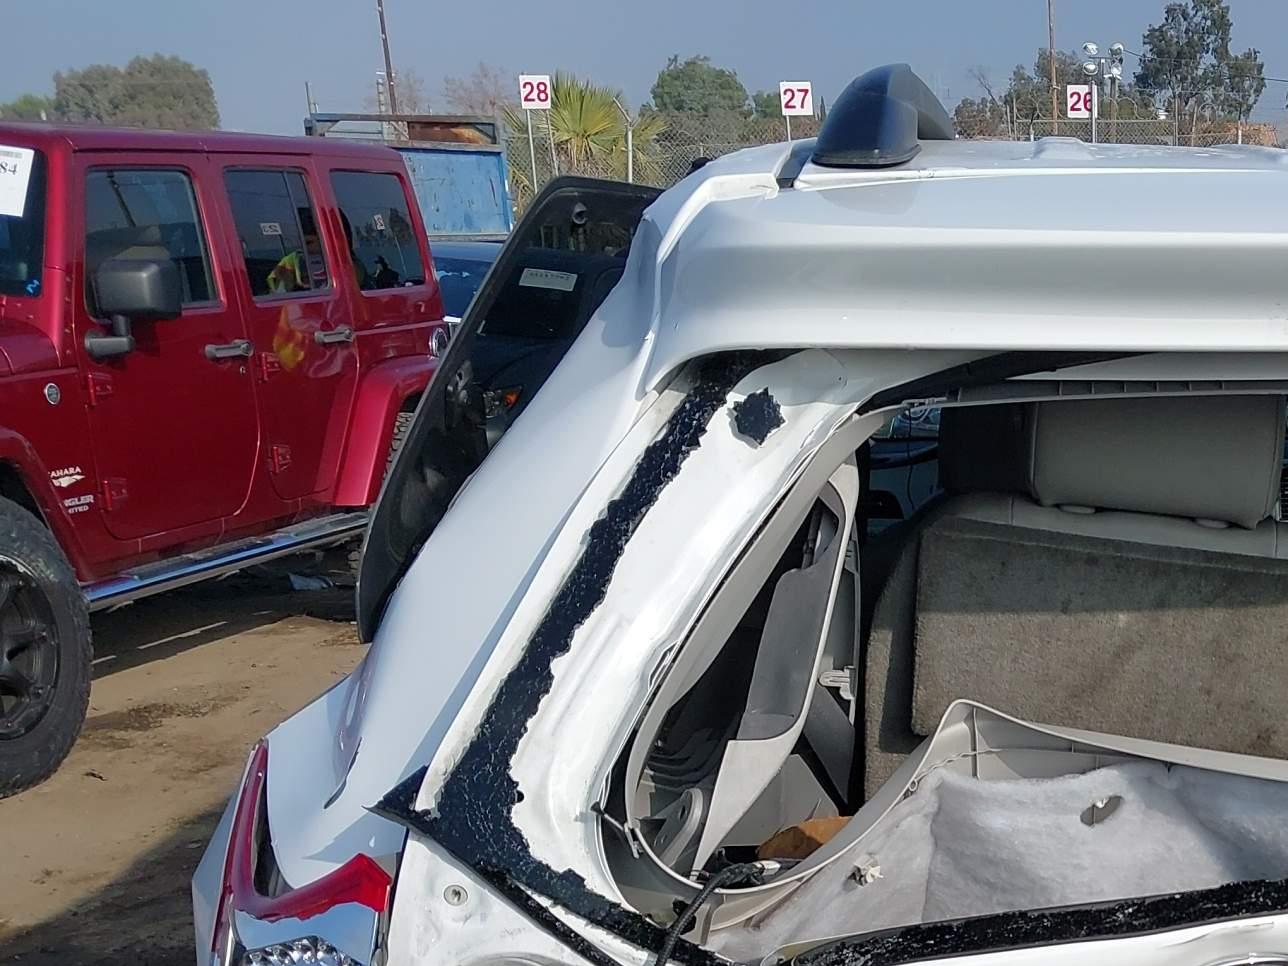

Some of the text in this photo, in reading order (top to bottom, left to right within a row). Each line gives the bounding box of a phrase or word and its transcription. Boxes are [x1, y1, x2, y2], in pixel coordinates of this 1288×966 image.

[523, 81, 549, 102] 28
[783, 88, 809, 109] 27
[48, 466, 82, 478] AHARA
